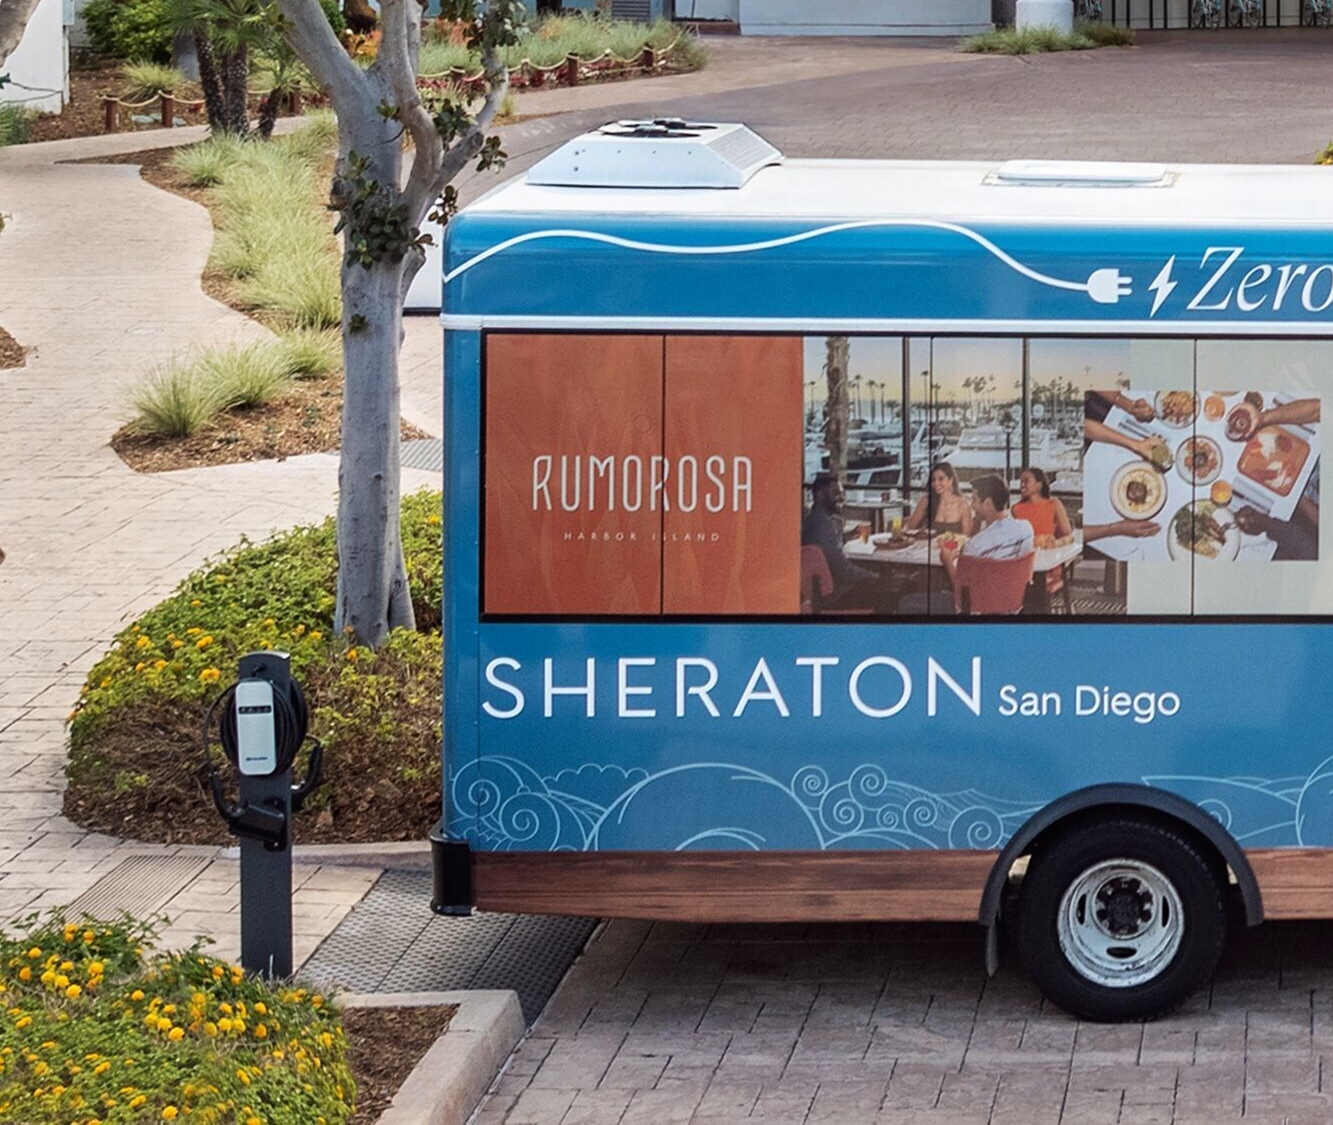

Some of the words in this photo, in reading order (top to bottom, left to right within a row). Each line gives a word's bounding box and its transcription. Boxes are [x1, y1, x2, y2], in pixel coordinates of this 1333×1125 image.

[532, 454, 753, 513] RUMOROSA
[563, 532, 638, 542] HARBOR
[481, 655, 982, 719] SHERATON
[997, 684, 1062, 716] San
[1074, 685, 1181, 725] Diego
